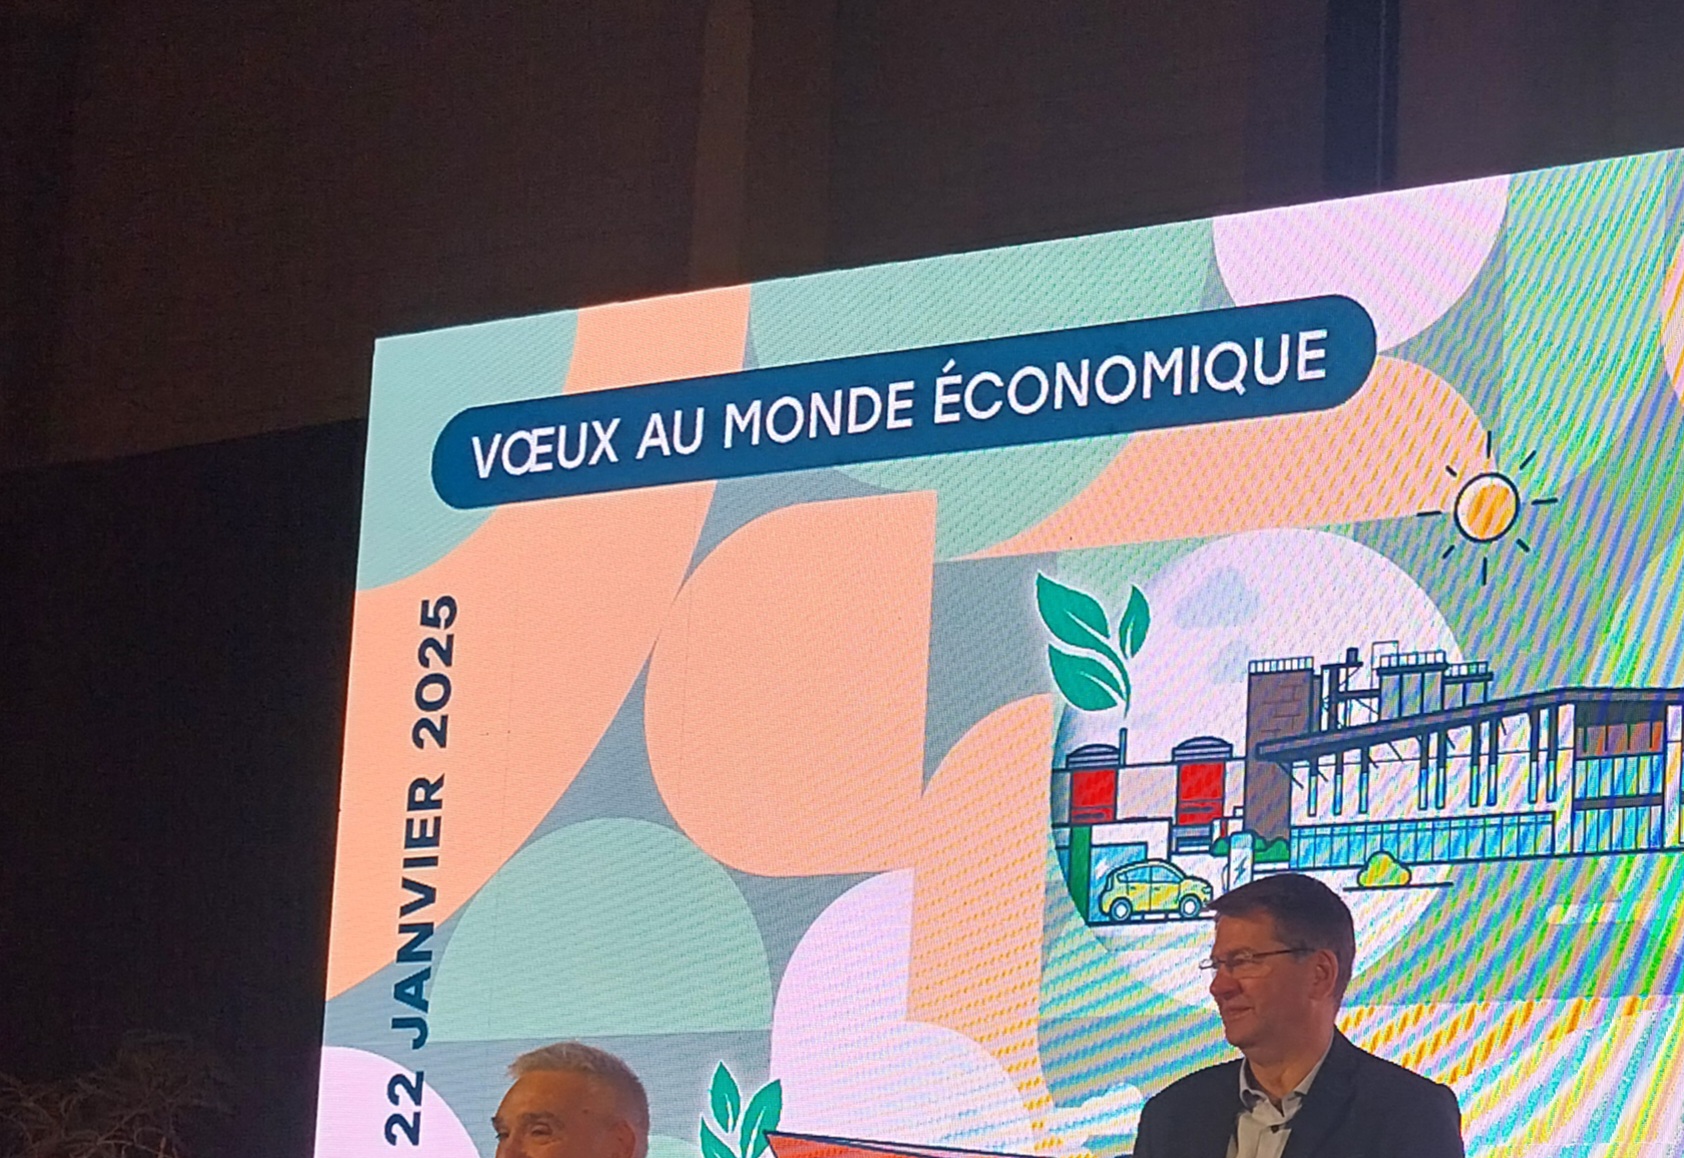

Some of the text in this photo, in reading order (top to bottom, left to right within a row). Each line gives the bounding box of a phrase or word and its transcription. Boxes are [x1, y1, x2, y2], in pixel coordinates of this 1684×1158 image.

[471, 328, 1328, 479] VŒUX AU MONDE ÉCONOMIQUE
[411, 594, 458, 750] 2025
[391, 772, 446, 1050] JANVIER
[384, 1070, 425, 1147] 22
